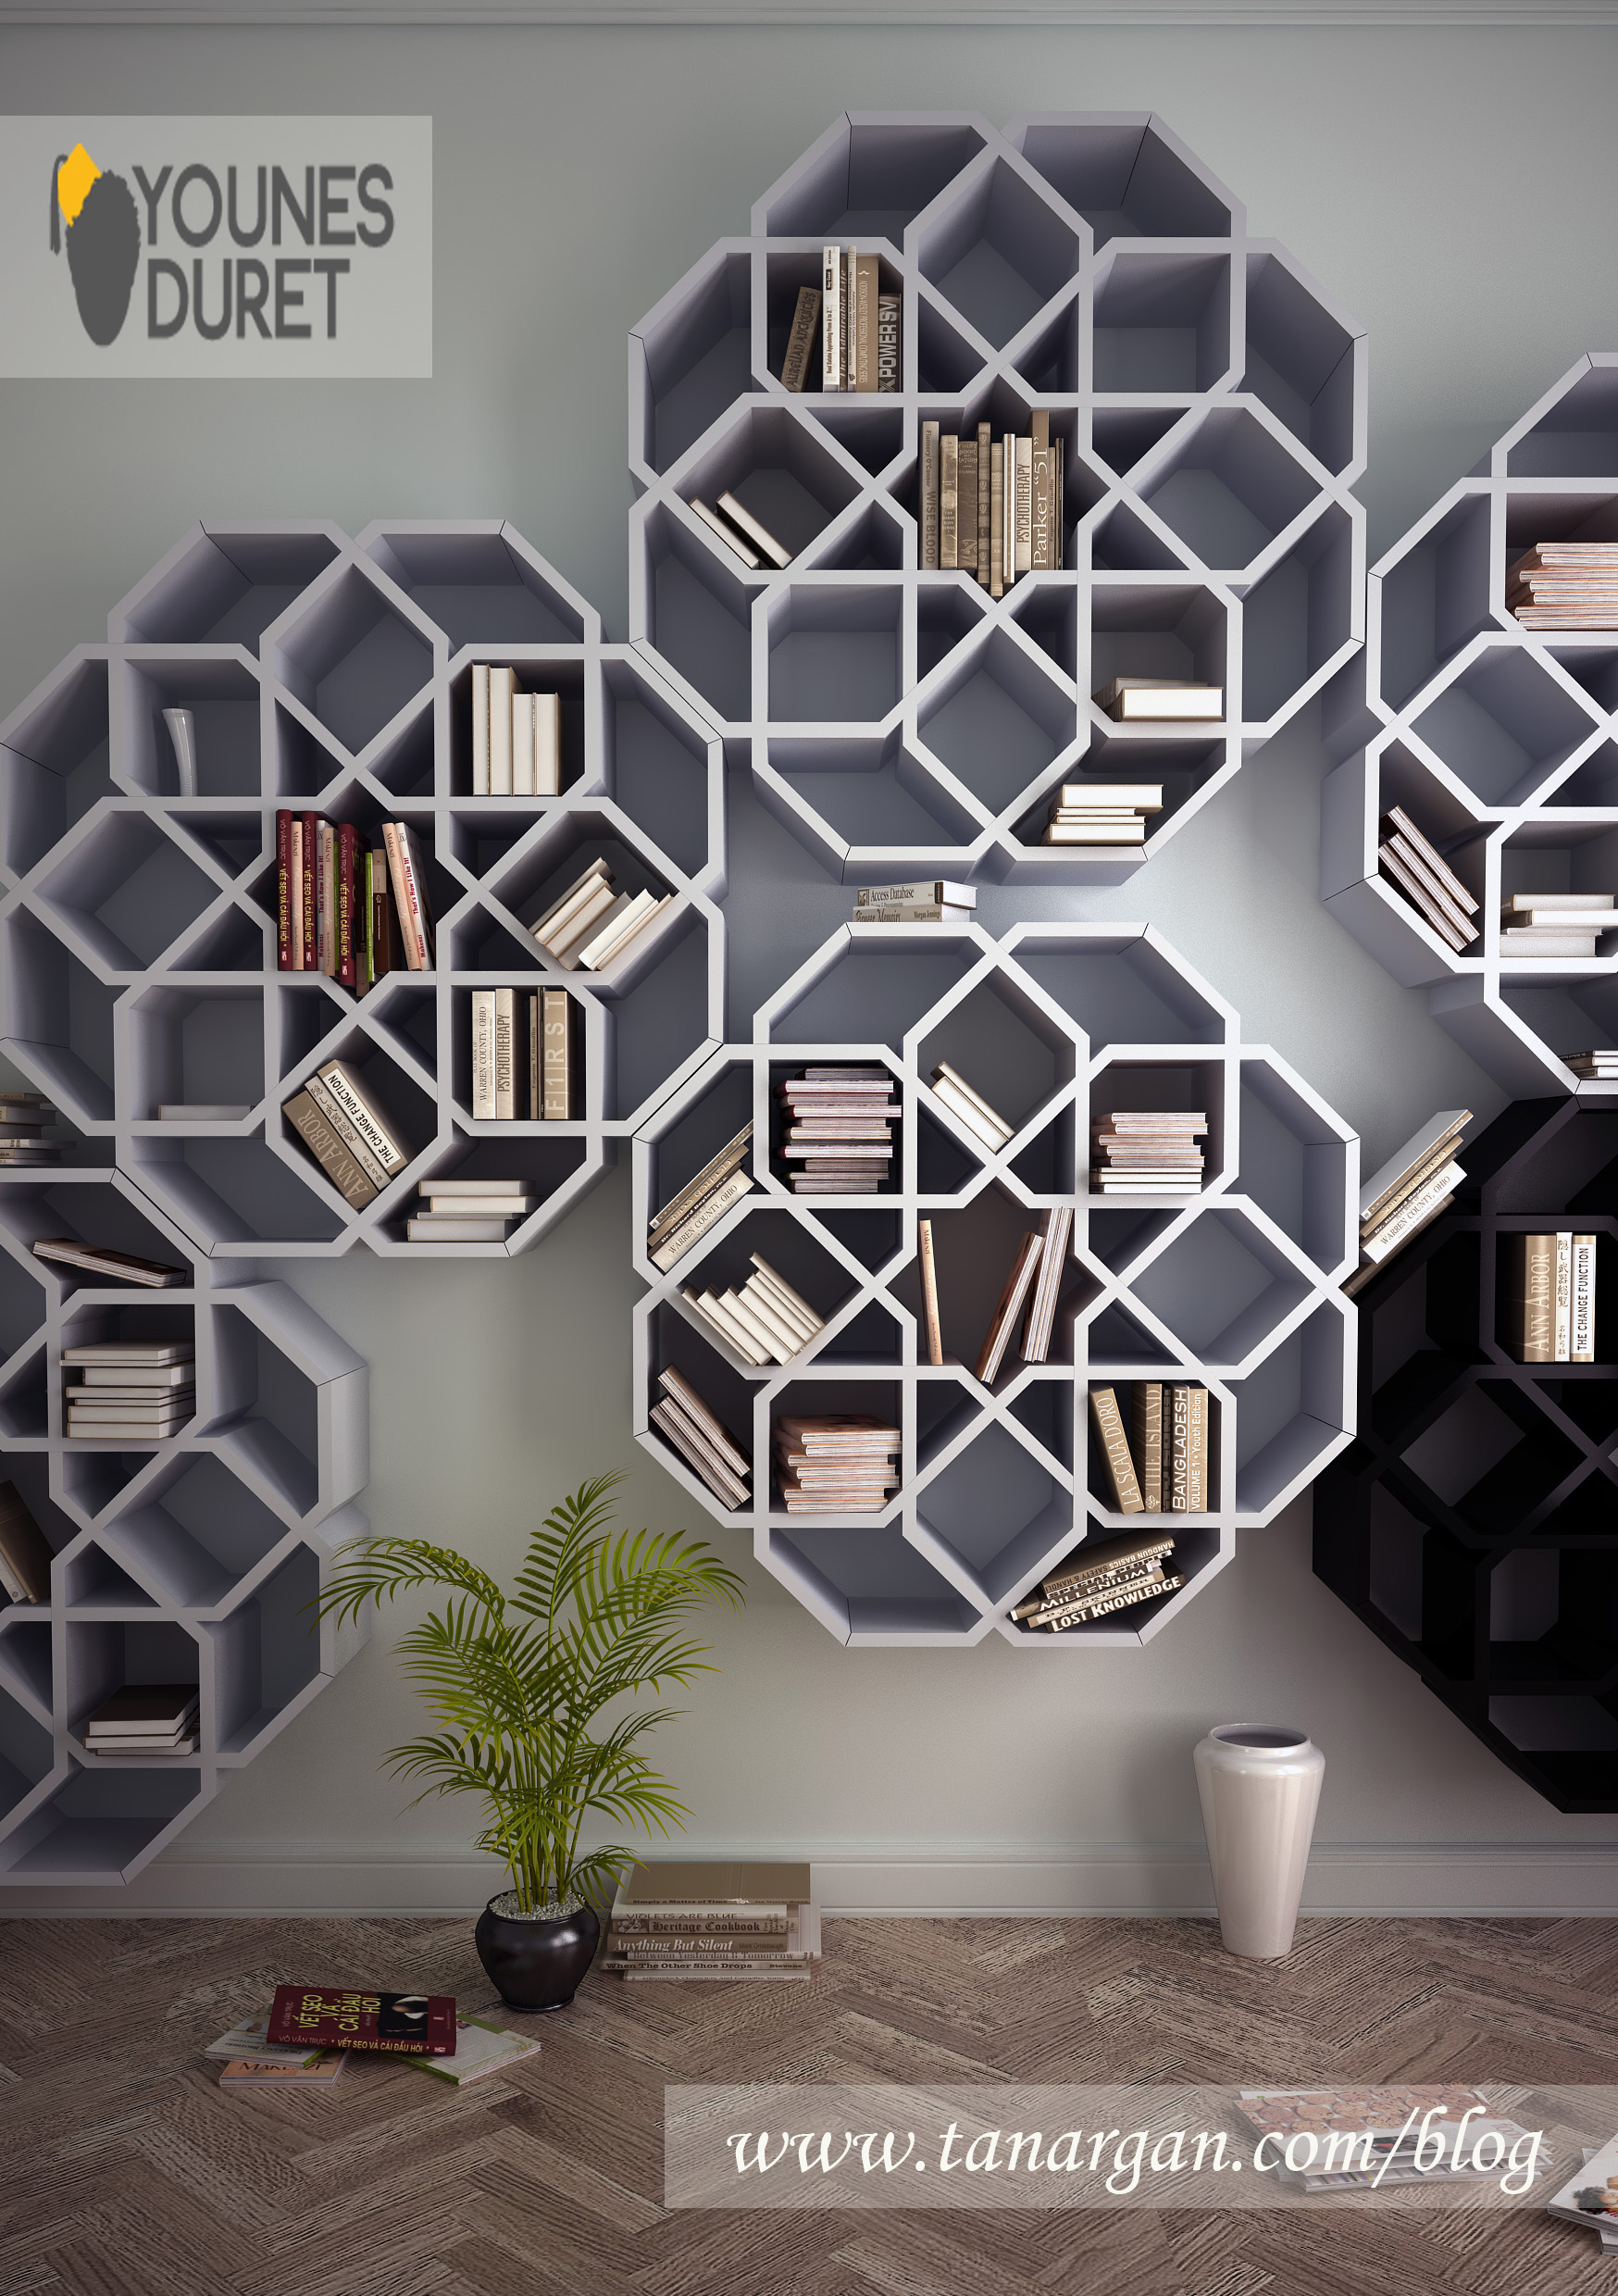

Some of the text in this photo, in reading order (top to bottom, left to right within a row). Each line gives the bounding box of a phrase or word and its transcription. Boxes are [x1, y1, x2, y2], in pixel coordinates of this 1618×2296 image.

[926, 491, 936, 521] WISE
[1016, 464, 1030, 543] PSYCHOTHERAPY
[926, 525, 936, 564] BLOOD
[1033, 492, 1047, 565] Parker
[410, 896, 419, 915] That's
[870, 887, 915, 902] Access Database
[417, 934, 426, 958] Makenzi
[479, 1029, 488, 1065] COUNTY,
[497, 1015, 510, 1092] PSYCHOTHERAPY
[328, 1074, 394, 1164] THE CHANGE FUNCTION
[297, 1109, 369, 1198] ANN ARBOR
[661, 1233, 671, 1243] Dr.
[670, 1210, 694, 1233] Richard
[668, 1184, 738, 1254] WARREN COUNTY, OHIO
[1375, 1224, 1385, 1234] Dr.
[1385, 1200, 1408, 1224] Richard
[1380, 1176, 1450, 1245] WARREN COUNTY, OHIO
[1525, 1254, 1550, 1352] ANN ARBOR
[1577, 1247, 1588, 1351] THE CHANGE FUNCTION
[1192, 1394, 1201, 1424] Edition
[1096, 1397, 1140, 1504] LA SCALA D'ORO
[1145, 1389, 1161, 1490] THE ISLAND
[1173, 1389, 1187, 1509] BANGLADESH
[1192, 1427, 1201, 1454] Youth
[1191, 1470, 1201, 1509] VOLUME
[1109, 1554, 1136, 1569] BASICS
[1137, 1541, 1174, 1559] HANDGUN
[1081, 1565, 1108, 1579] SAFETY
[1051, 1576, 1181, 1632] LOST KNOWLEDGE
[652, 1922, 702, 1932] Heritage
[705, 1922, 760, 1931] Cookbook
[614, 1939, 733, 1952] Anything But Silent
[678, 1952, 728, 1960] Yesterday
[239, 2063, 320, 2071] MAKZI
